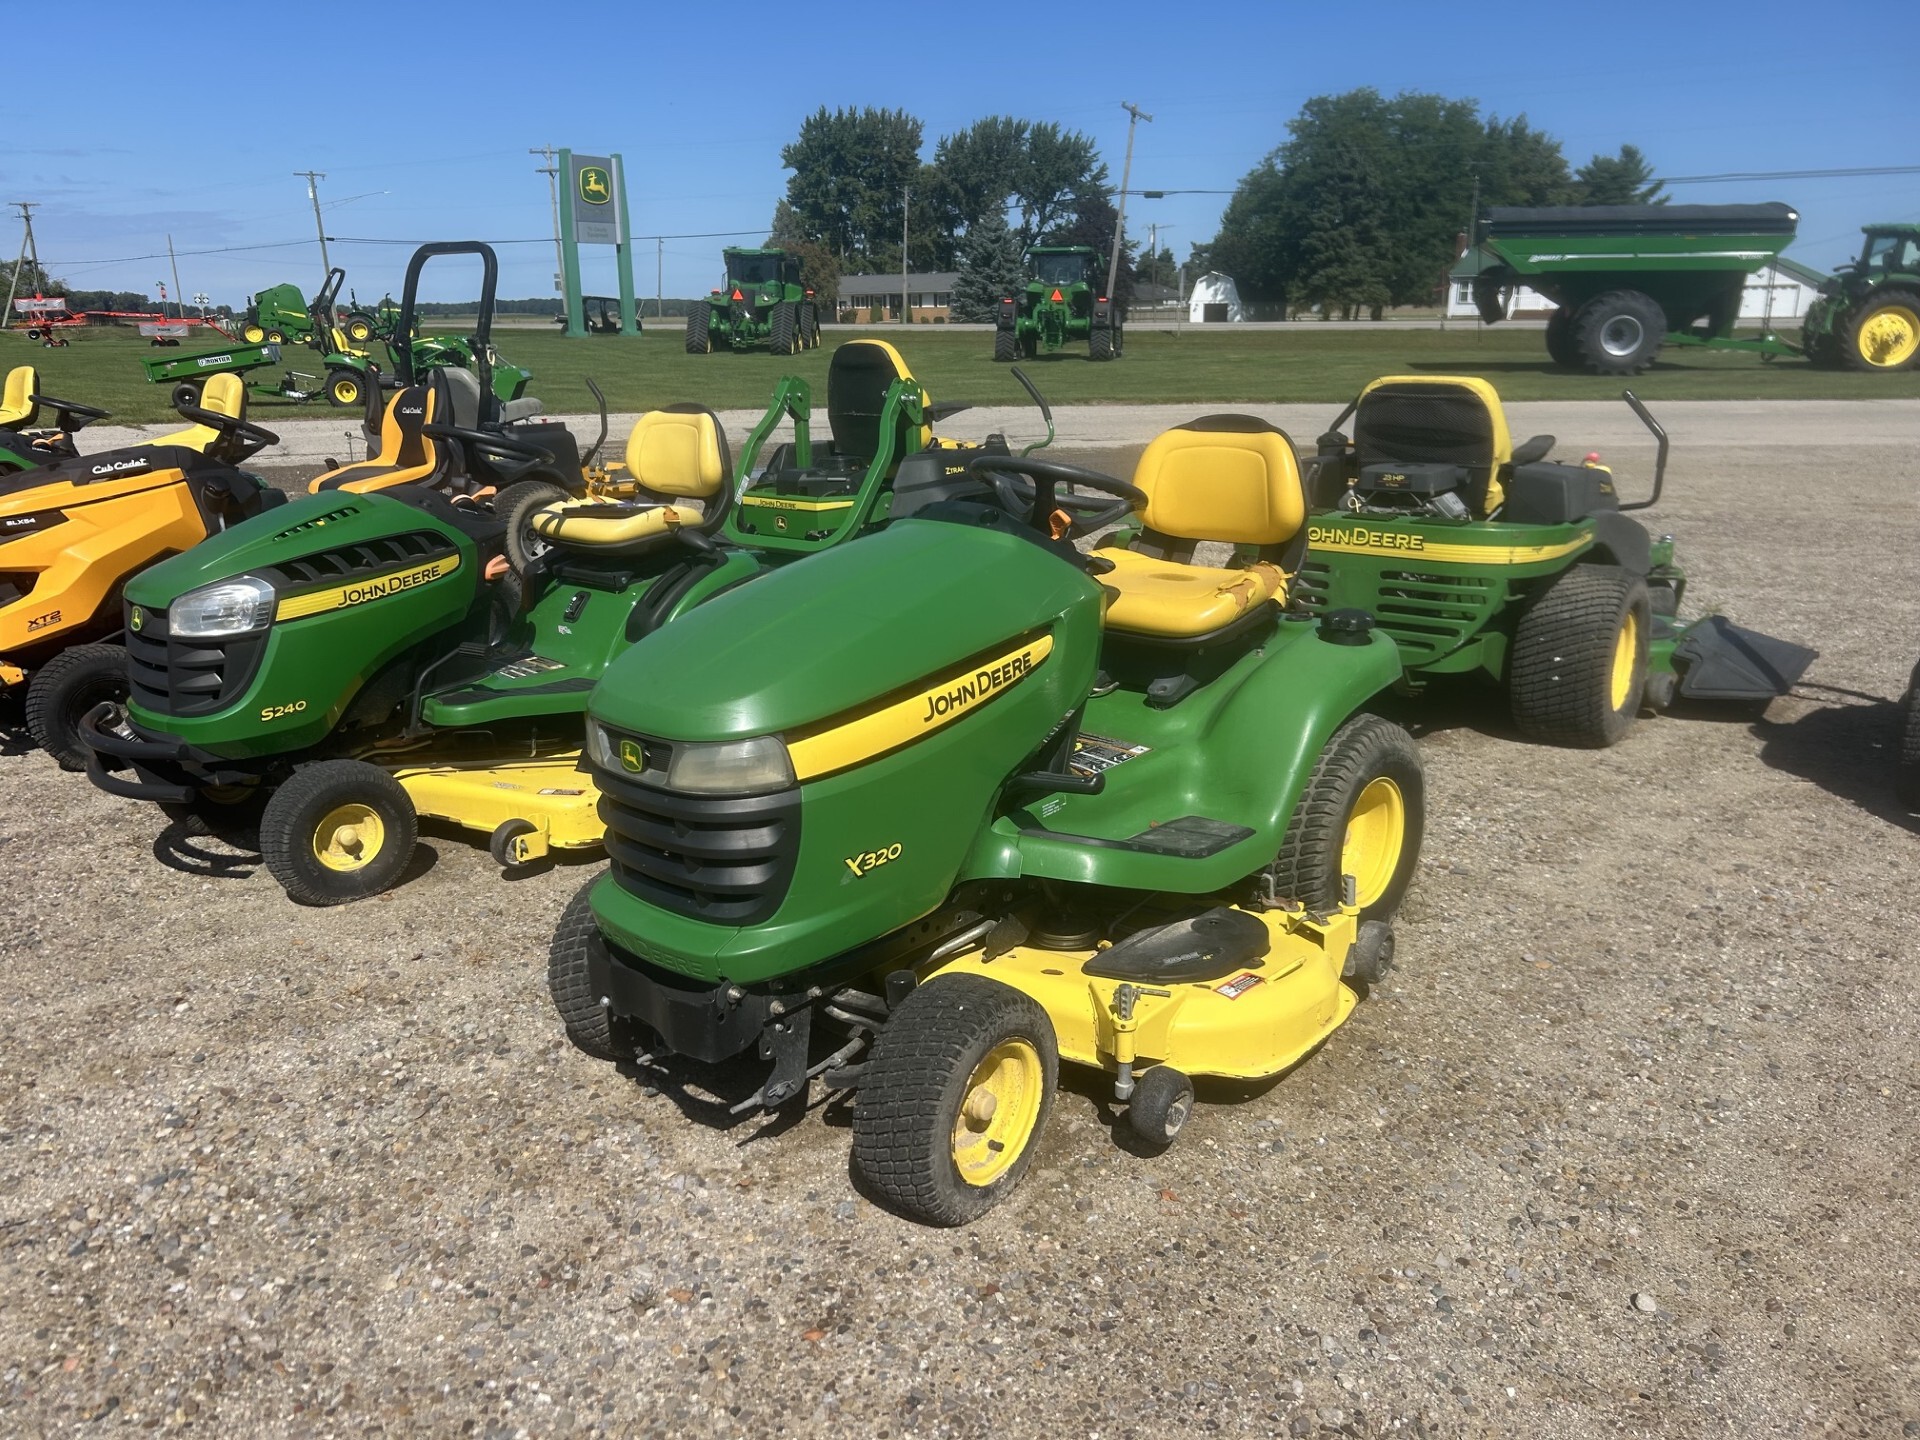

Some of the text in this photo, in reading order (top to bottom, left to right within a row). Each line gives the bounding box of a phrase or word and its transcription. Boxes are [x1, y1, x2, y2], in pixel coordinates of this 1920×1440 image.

[92, 458, 149, 474] Cub Cadet
[759, 499, 797, 509] JOHN DEERE
[1307, 527, 1424, 550] OHN DEERE
[338, 565, 441, 606] JOHN DEERE
[28, 610, 61, 627] XT2
[923, 651, 1032, 723] JOHN DEERE
[261, 700, 307, 722] S240
[844, 842, 903, 878] X320
